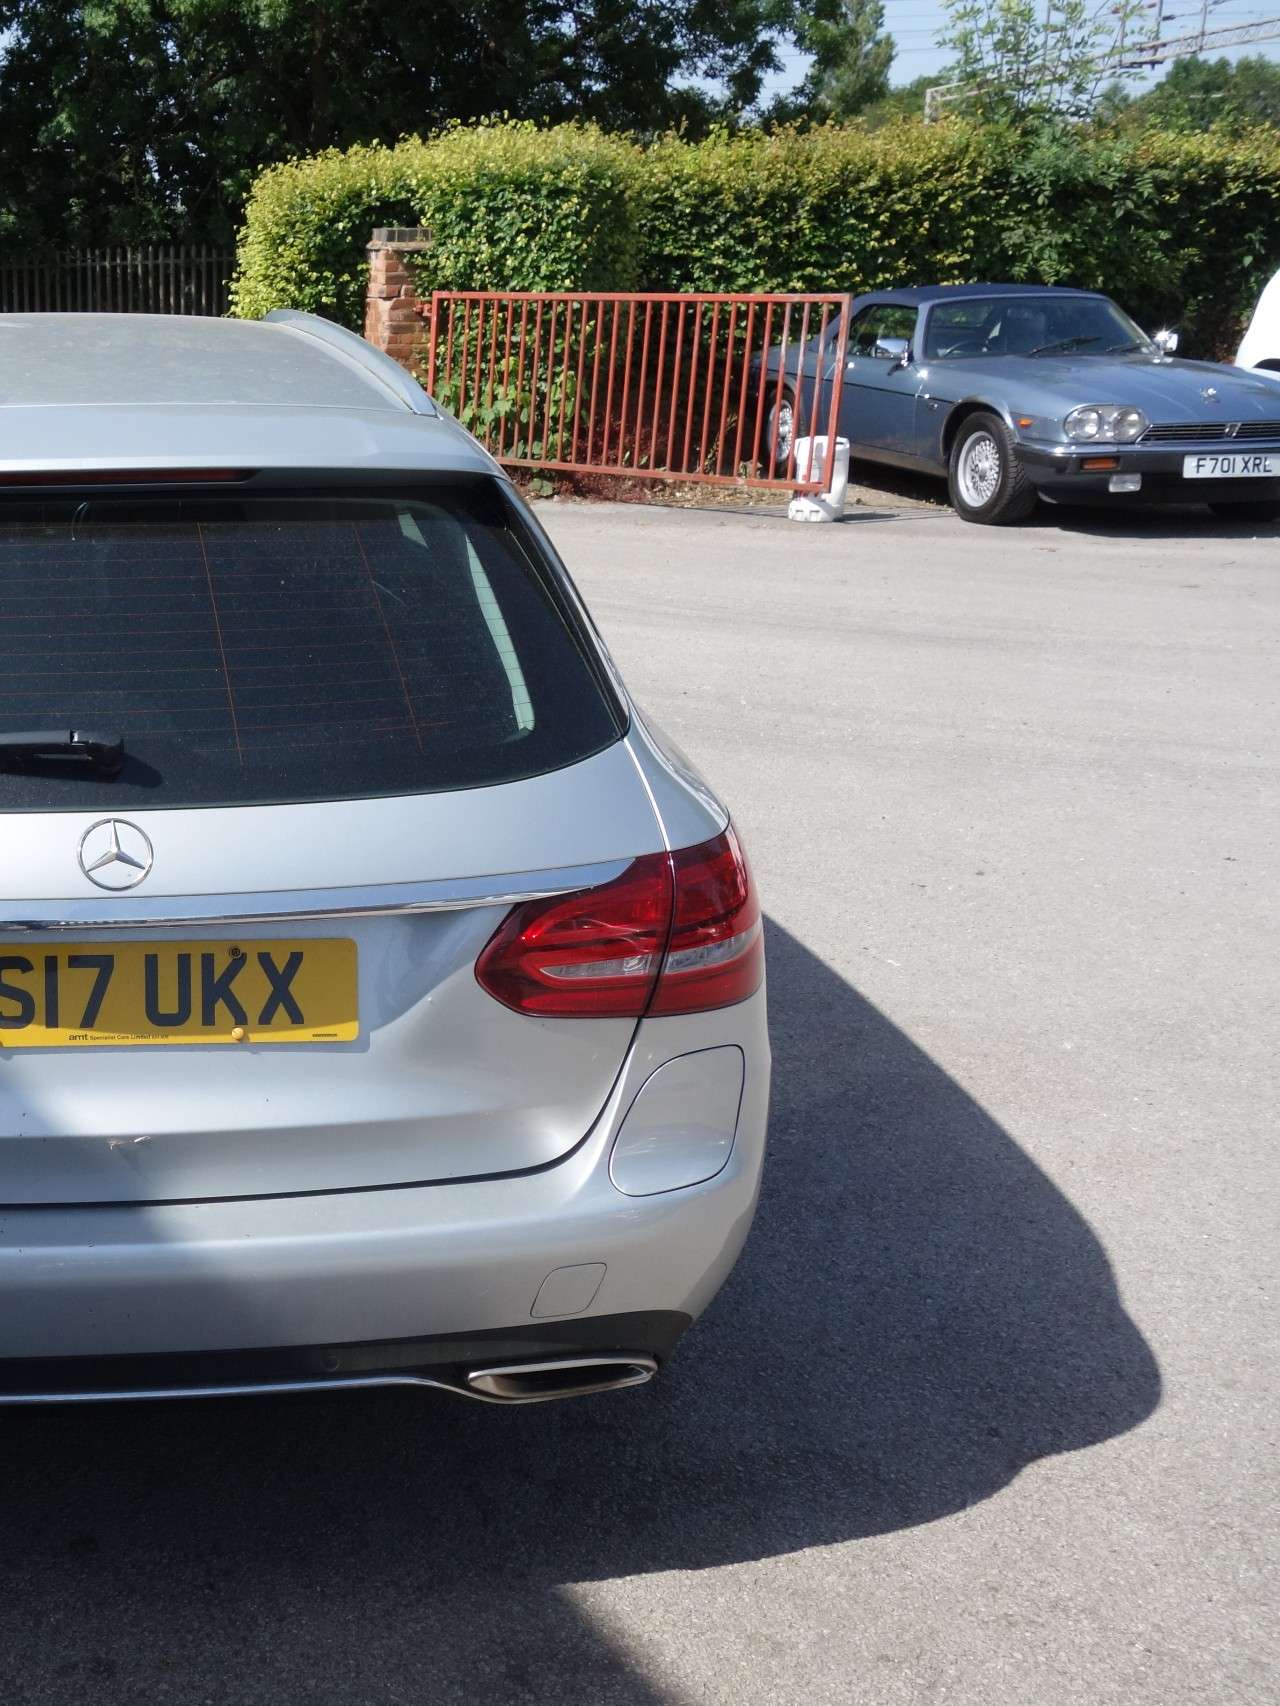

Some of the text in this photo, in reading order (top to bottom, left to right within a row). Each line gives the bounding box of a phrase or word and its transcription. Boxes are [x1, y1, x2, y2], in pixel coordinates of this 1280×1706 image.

[1195, 456, 1273, 474] F701 XRL
[144, 951, 305, 1027] UKX
